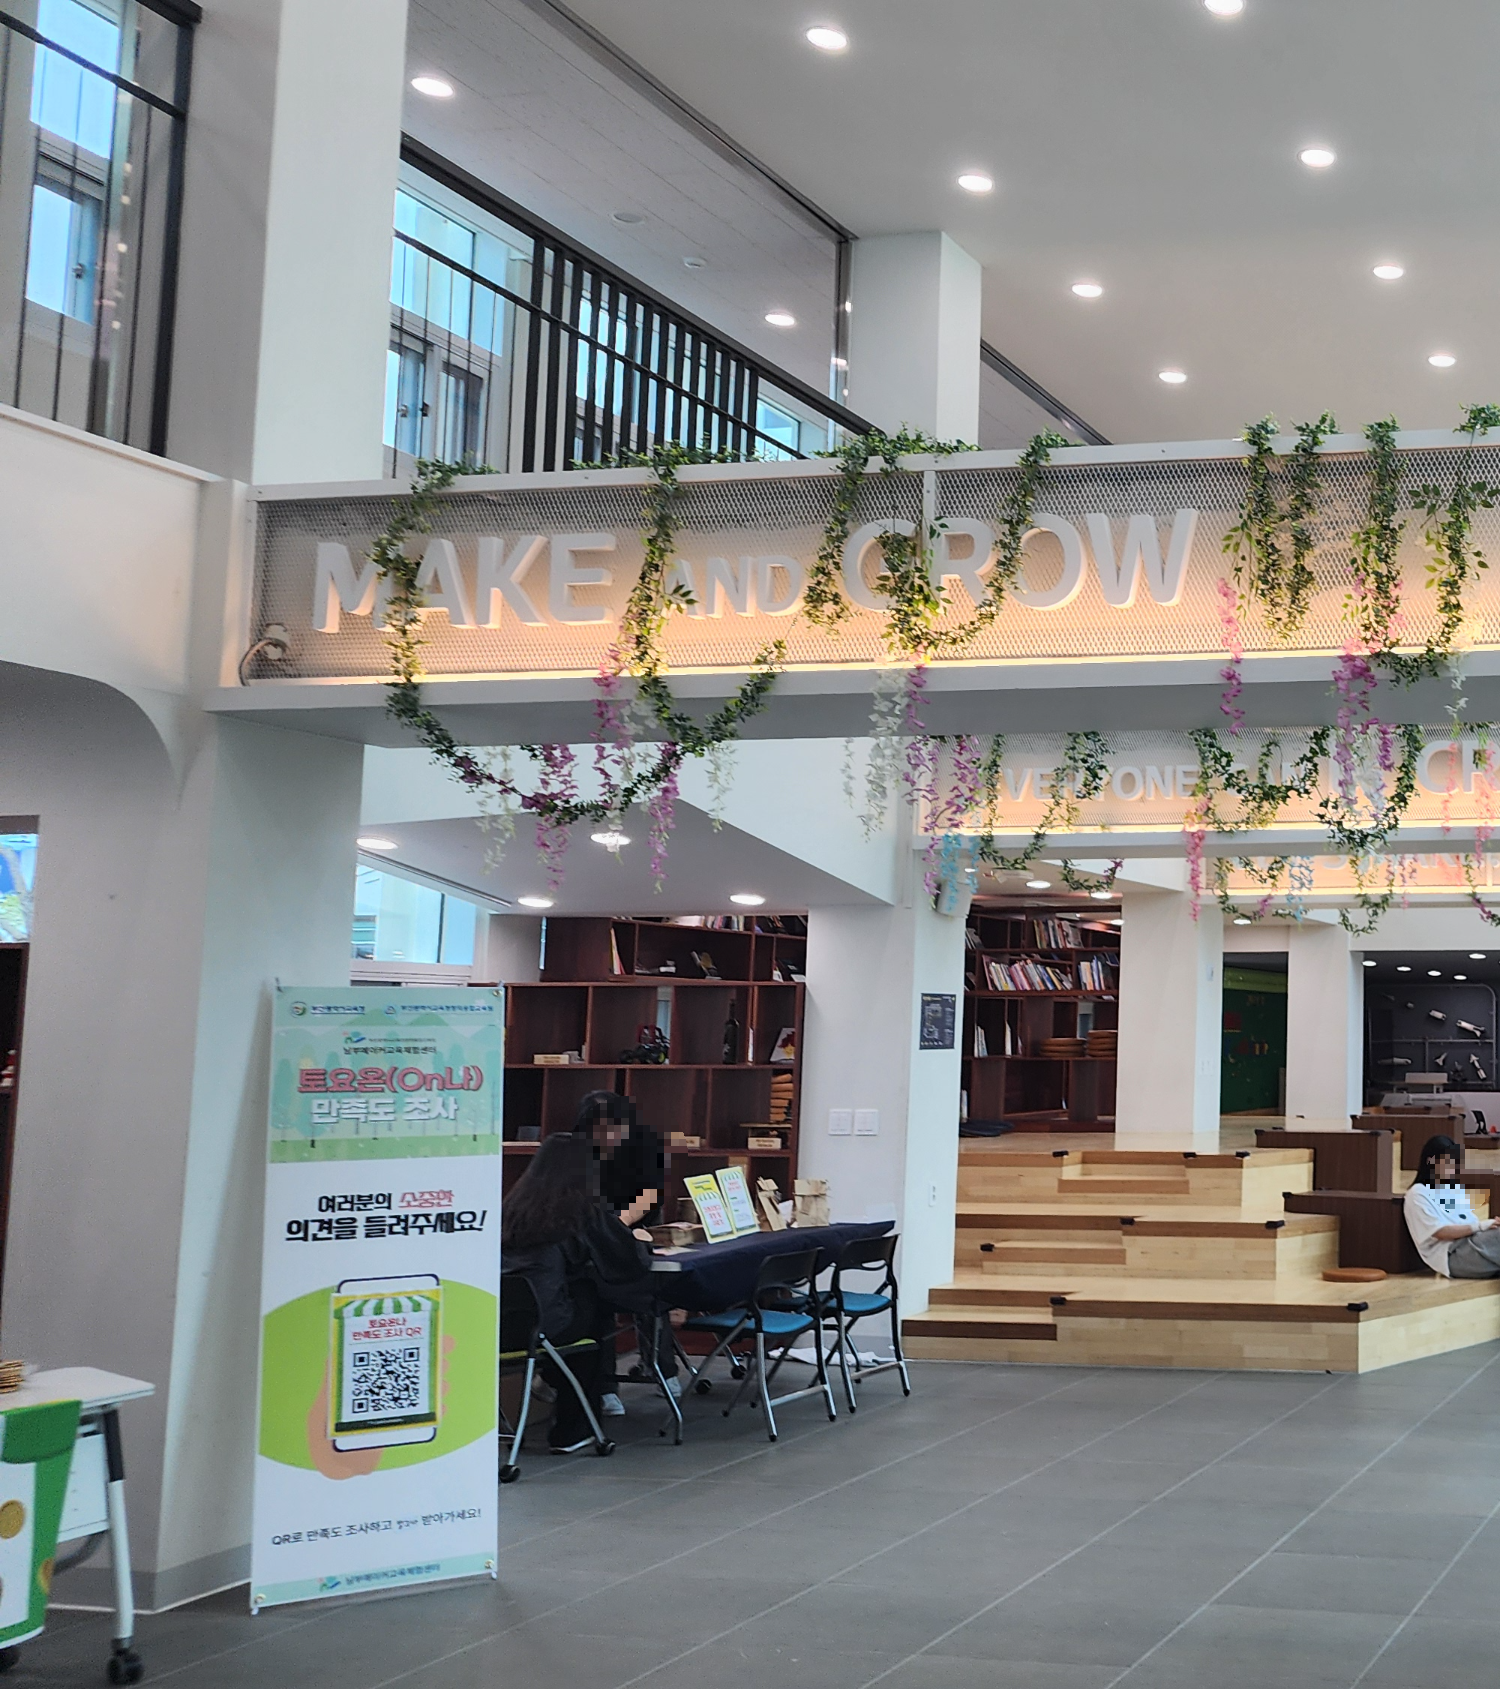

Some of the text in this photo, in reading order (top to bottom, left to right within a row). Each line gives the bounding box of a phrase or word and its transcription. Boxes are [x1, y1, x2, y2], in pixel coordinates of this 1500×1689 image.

[312, 508, 1198, 634] MAKE AND GROW
[311, 1096, 460, 1125] 만족도 조사
[317, 1188, 456, 1214] 여러분의 소중한
[285, 1209, 488, 1242] 의견을 들려주세요!
[384, 1327, 403, 1338] 조사
[405, 1326, 422, 1338] QR
[271, 1531, 304, 1546] QR로
[306, 1527, 343, 1542] 만족도
[345, 1520, 392, 1536] 조사하고
[421, 1508, 482, 1527] 받아가세요!
